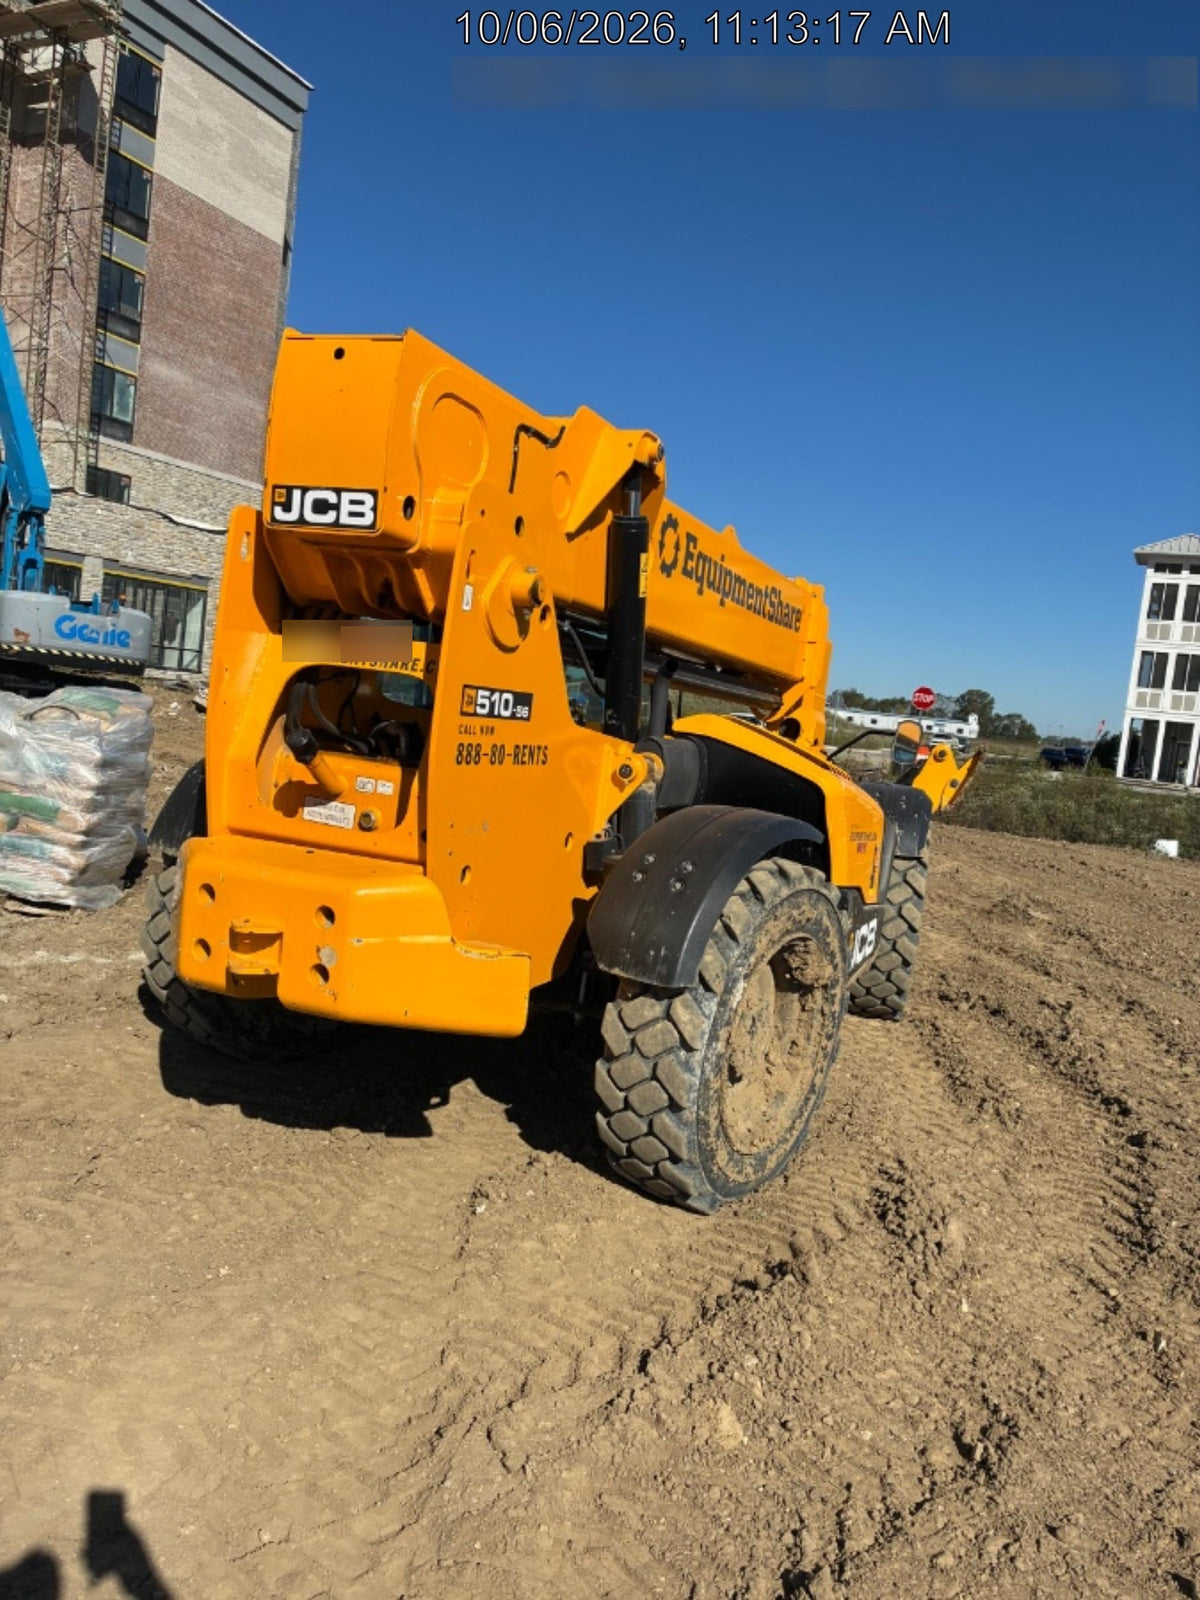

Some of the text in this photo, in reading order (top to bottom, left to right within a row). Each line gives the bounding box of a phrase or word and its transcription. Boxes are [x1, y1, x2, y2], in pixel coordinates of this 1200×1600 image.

[273, 488, 375, 527] JCB
[681, 531, 803, 634] EquipmentShare
[54, 614, 132, 648] Genie
[476, 689, 529, 718] 510-56
[913, 693, 935, 702] STOP
[458, 724, 495, 736] CALL NOW
[456, 742, 548, 766] 888-80-RENTS
